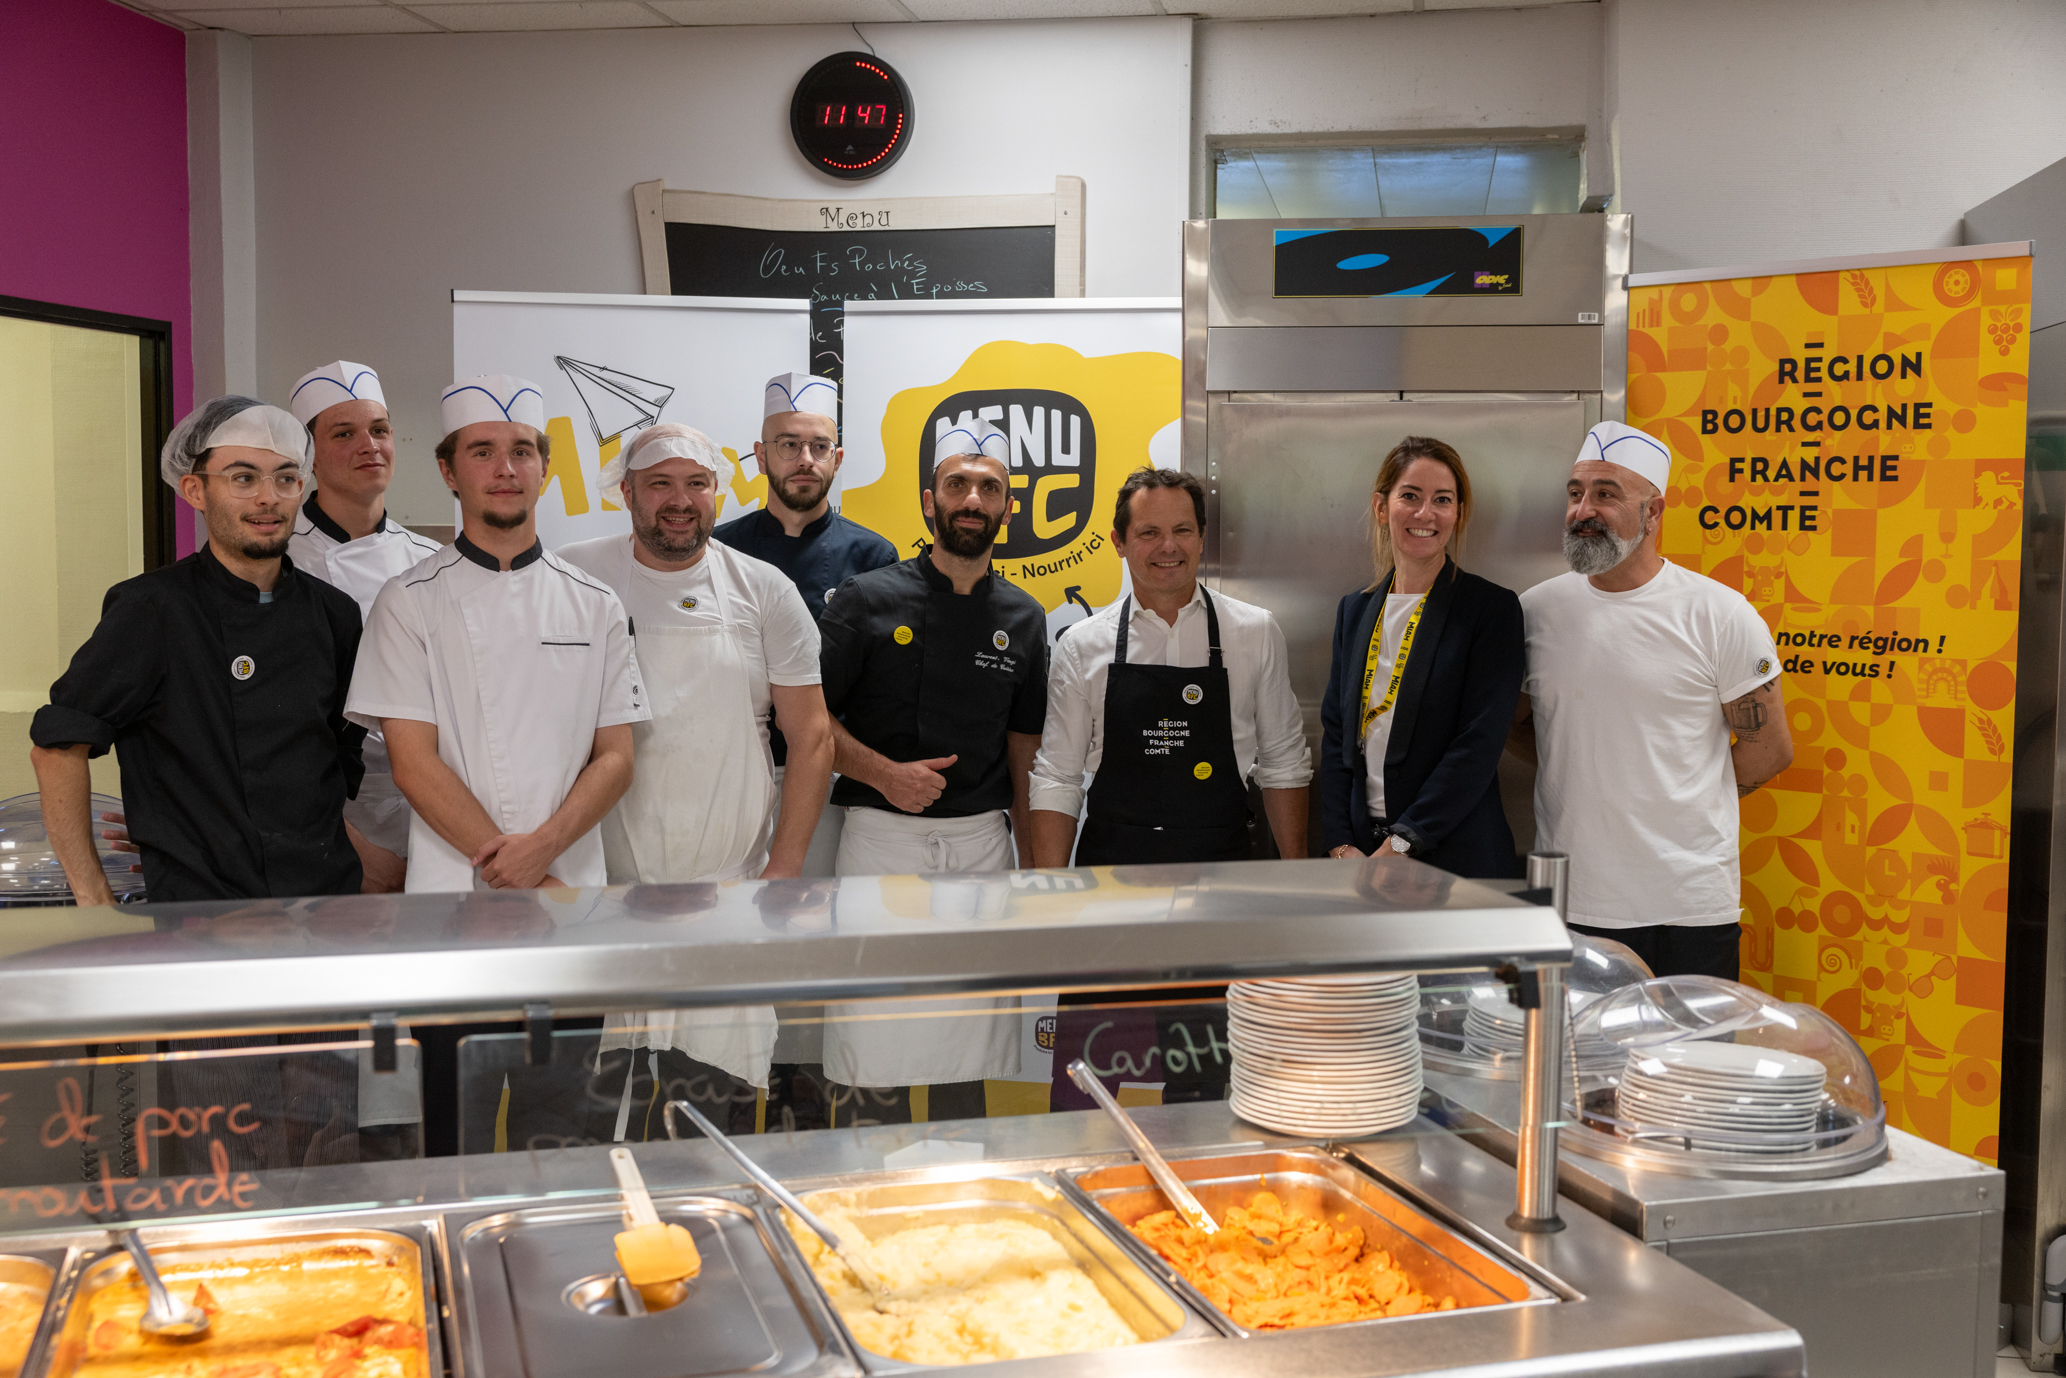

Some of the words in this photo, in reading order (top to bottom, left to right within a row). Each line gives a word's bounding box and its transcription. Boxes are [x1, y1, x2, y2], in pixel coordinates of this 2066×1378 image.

[820, 207, 891, 229] Menu
[811, 282, 861, 303] Sauce
[1701, 402, 1933, 435] BOURGOGNE
[1728, 454, 1900, 483] FRANCHE
[1021, 550, 1085, 579] Nourrir
[1082, 531, 1106, 555] ici
[1776, 629, 1841, 650] notre
[1848, 632, 1930, 657] région
[1936, 635, 1947, 655] !
[1783, 654, 1814, 675] de
[1822, 659, 1881, 679] vous
[1886, 660, 1896, 679] !
[1142, 729, 1190, 737] BOURGOGNE
[1149, 739, 1185, 747] FRANCHE
[1083, 1021, 1229, 1077] Carott
[136, 1102, 261, 1171] porc
